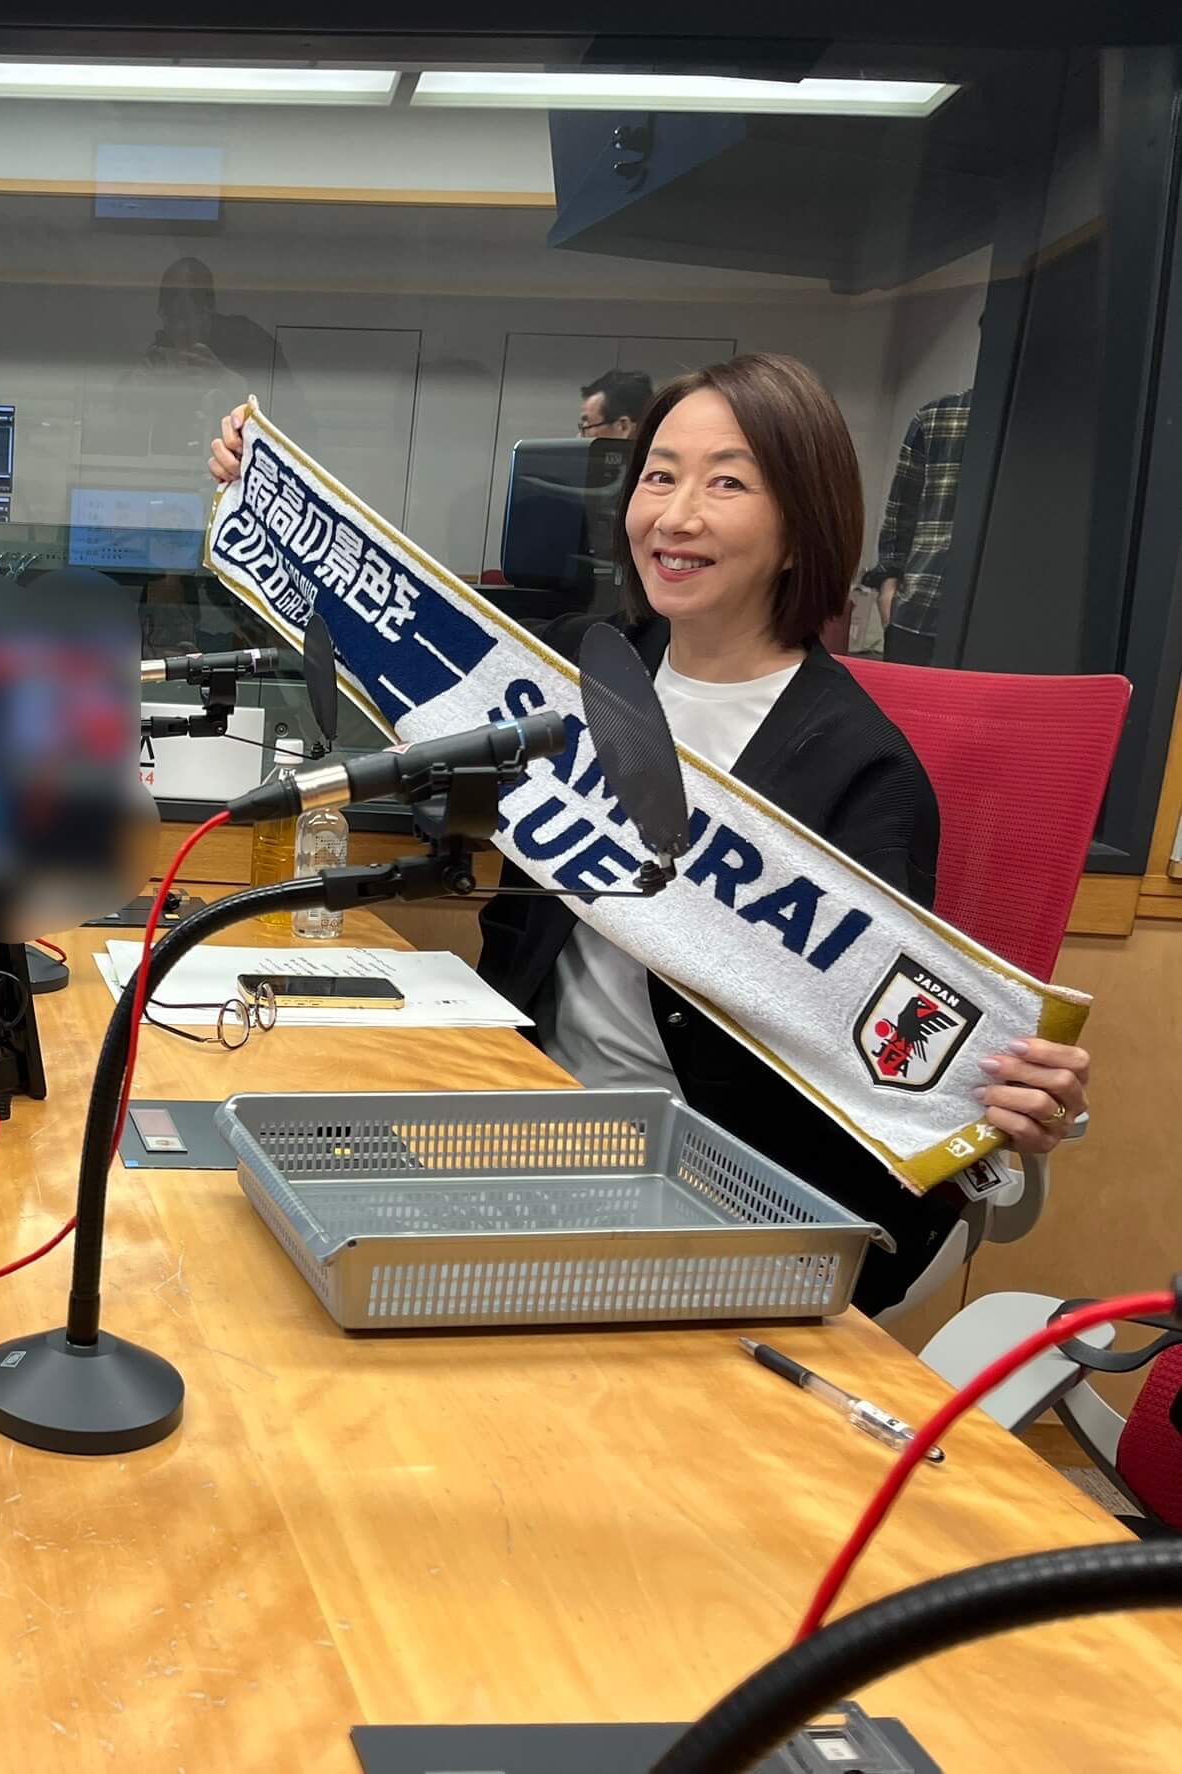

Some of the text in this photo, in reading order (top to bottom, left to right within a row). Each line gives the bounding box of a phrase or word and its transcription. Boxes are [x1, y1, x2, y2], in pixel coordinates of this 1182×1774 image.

[244, 447, 421, 643] 最高の景色を
[487, 678, 873, 973] SARAI
[913, 972, 960, 1009] JAPAN
[870, 1038, 913, 1078] JFA
